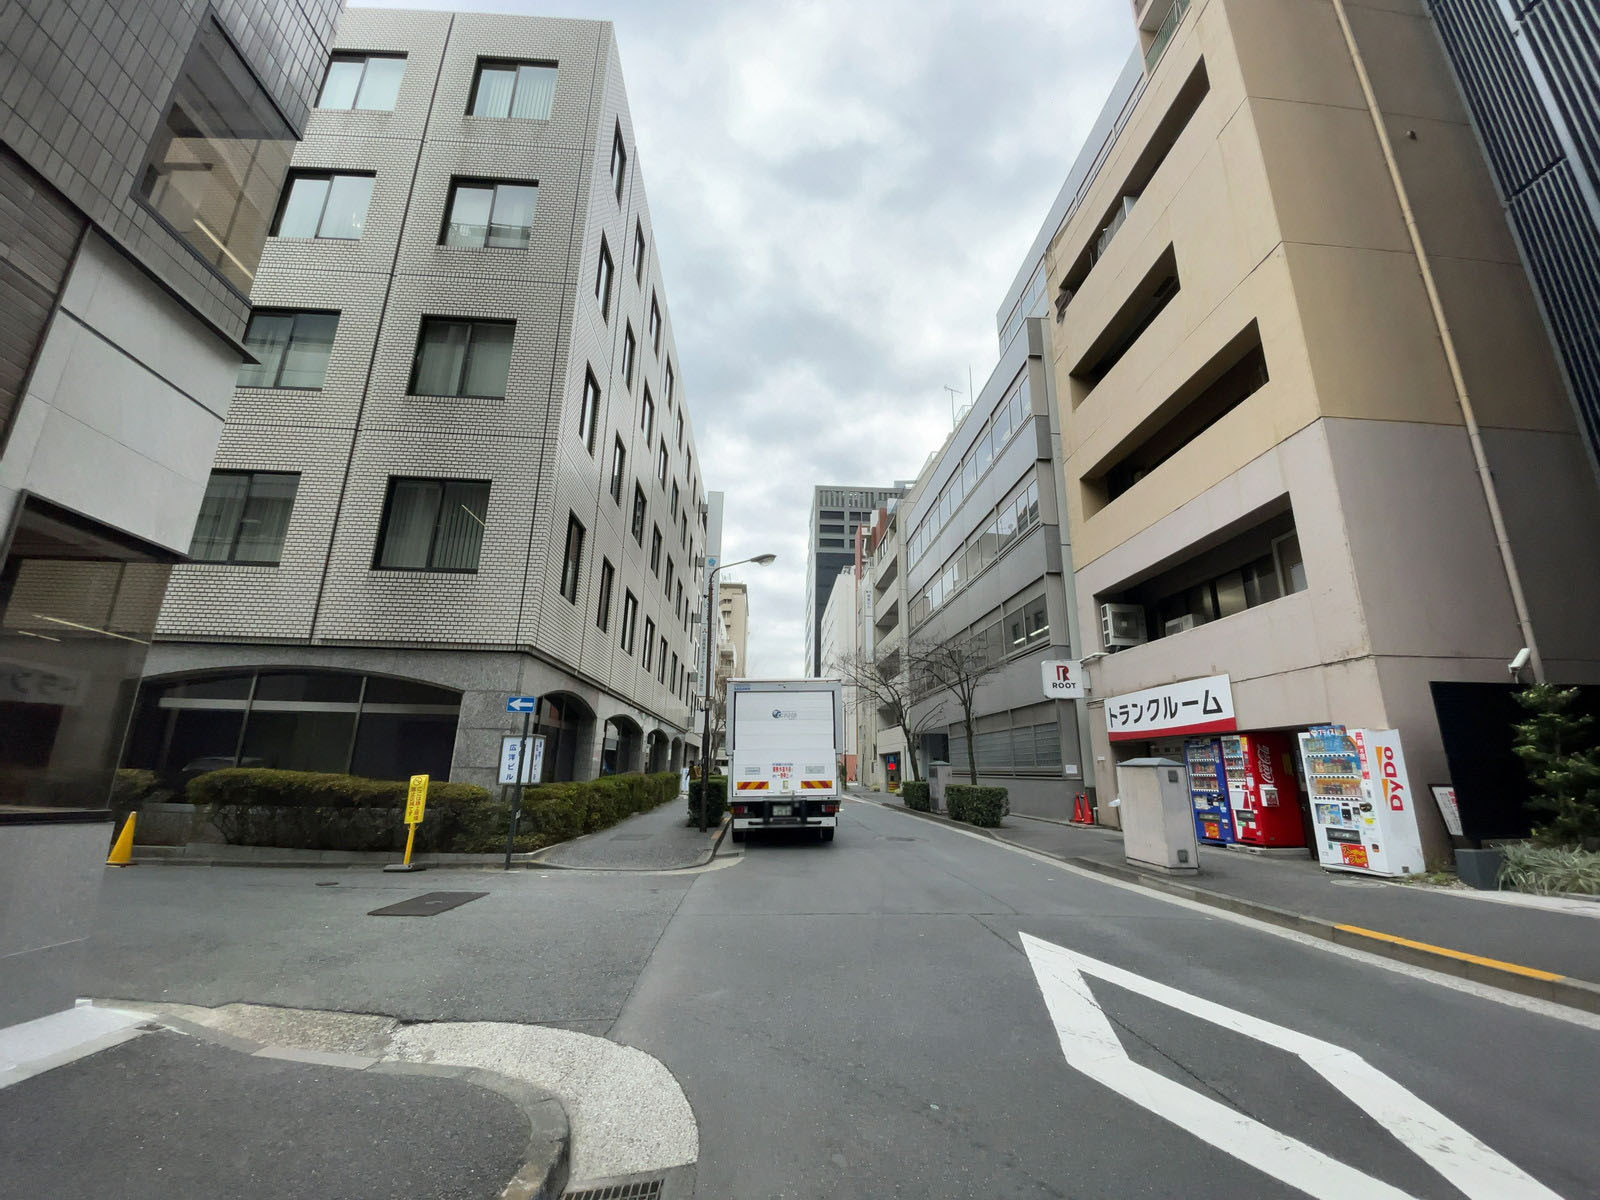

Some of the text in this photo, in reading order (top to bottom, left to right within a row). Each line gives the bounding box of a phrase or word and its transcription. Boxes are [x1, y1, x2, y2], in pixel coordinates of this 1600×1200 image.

[1108, 689, 1224, 728] トランクルーム
